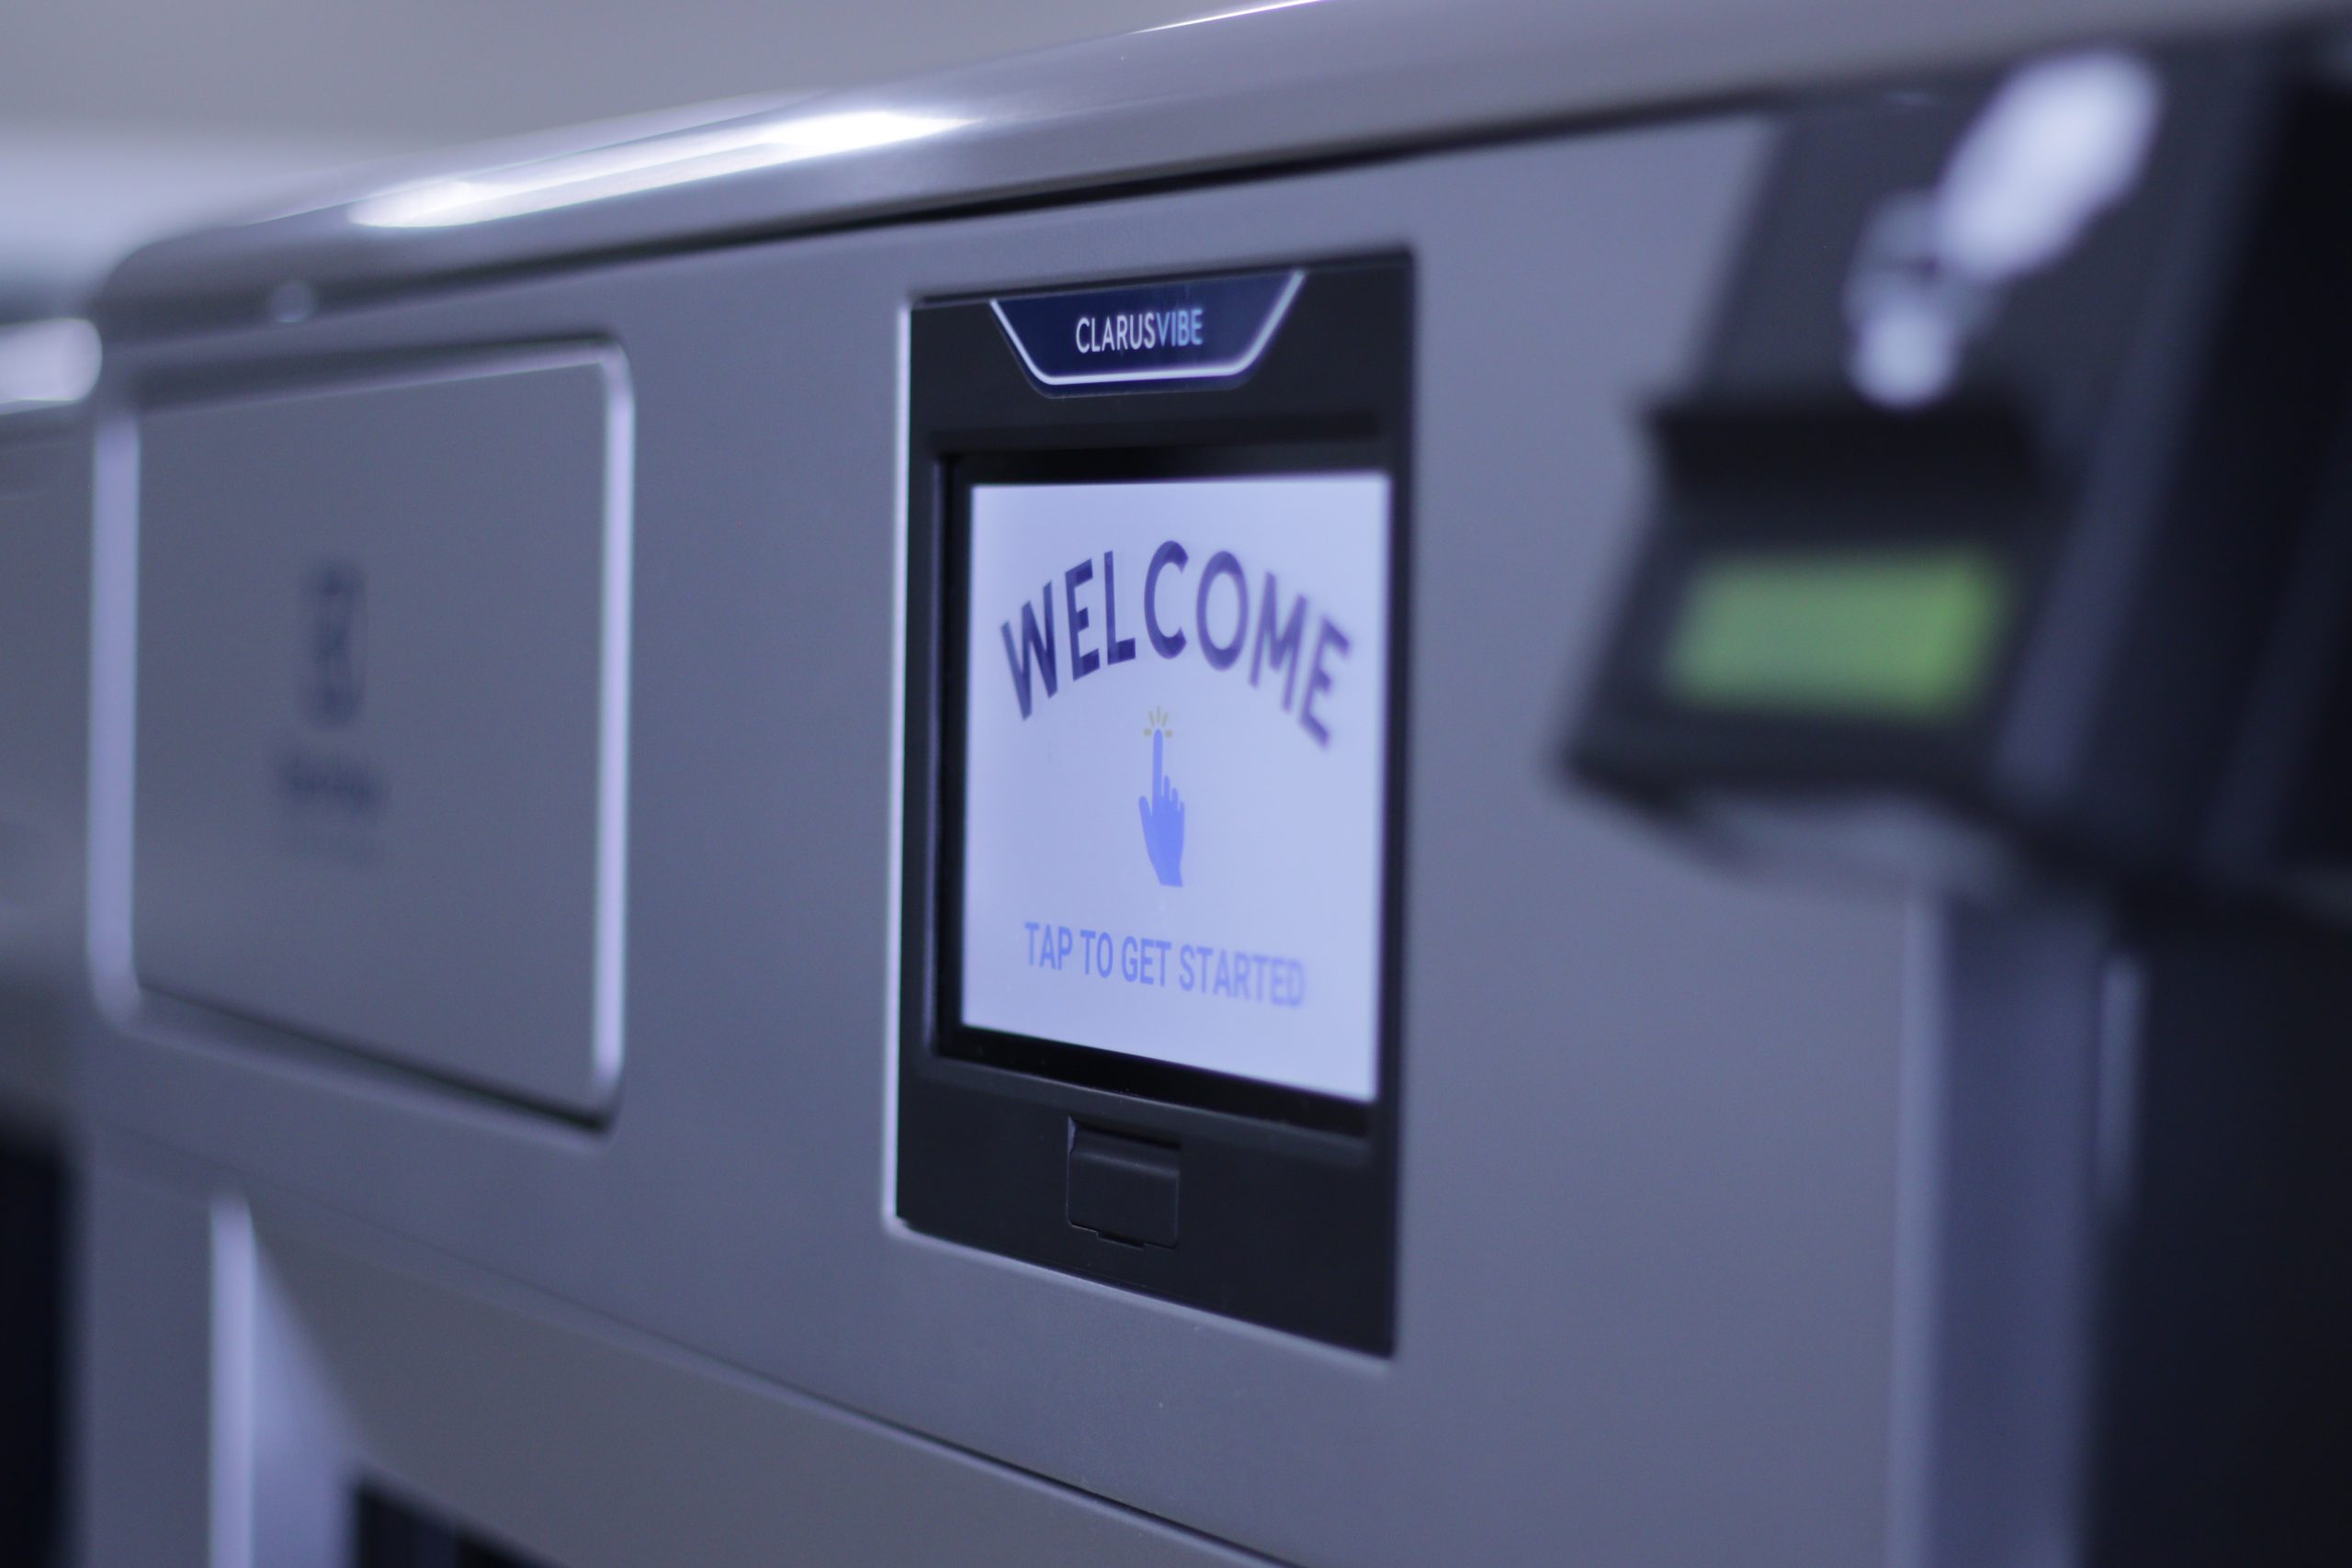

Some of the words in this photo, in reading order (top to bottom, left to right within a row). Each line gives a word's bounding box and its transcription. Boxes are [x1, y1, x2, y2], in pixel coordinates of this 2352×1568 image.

[1075, 309, 1204, 354] CLARUSVIBE
[1001, 540, 1352, 751] WELCOME
[1024, 921, 1074, 971] TAP
[1080, 929, 1114, 979] TO
[1121, 935, 1172, 987] GET
[1179, 943, 1306, 1009] STARTED
